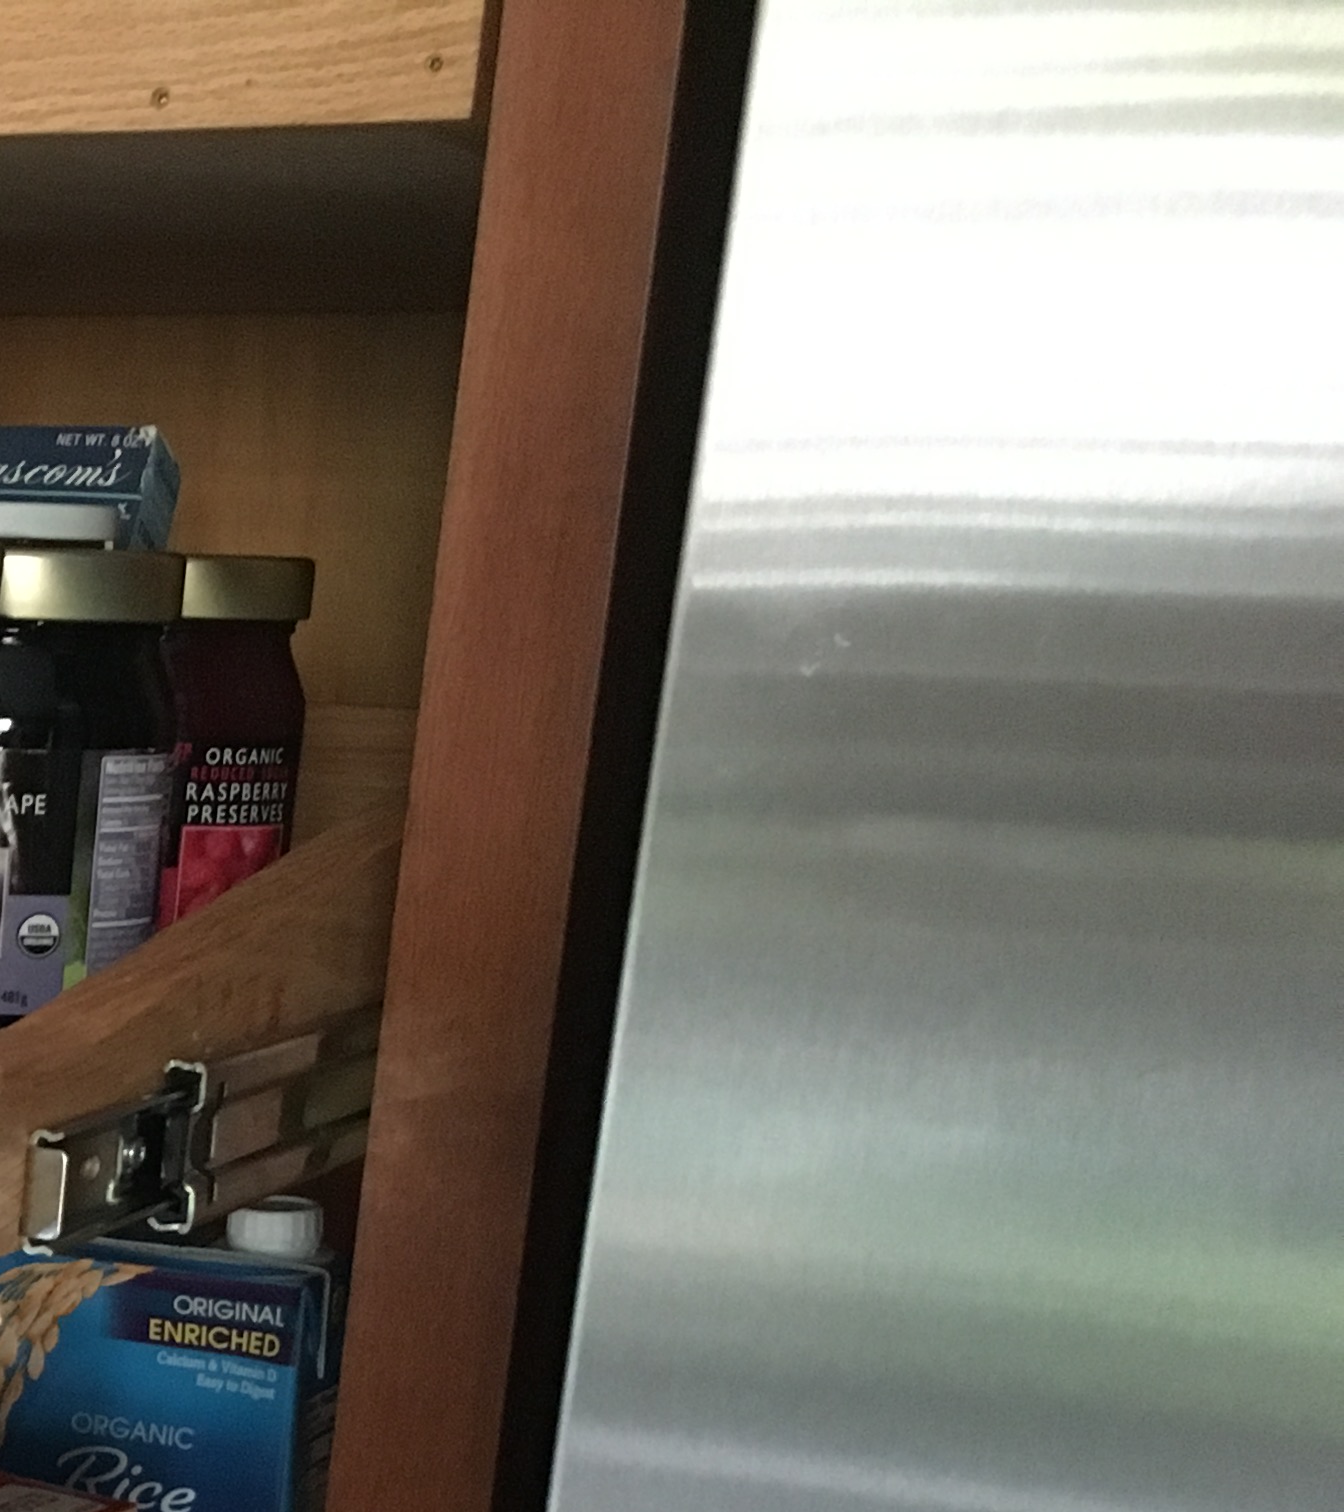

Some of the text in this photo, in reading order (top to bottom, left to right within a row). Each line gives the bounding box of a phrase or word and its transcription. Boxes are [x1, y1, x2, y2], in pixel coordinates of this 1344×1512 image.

[56, 432, 80, 447] NET
[84, 432, 108, 447] WT.
[205, 747, 284, 766] ORGANIC
[185, 781, 288, 802] RASPBERRY
[186, 803, 283, 825] PRESERVES
[173, 1294, 284, 1328] ORIGINAL
[148, 1317, 281, 1358] ENRICHED
[156, 1350, 206, 1371] Calcium
[221, 1360, 265, 1380] Vitamin
[266, 1368, 277, 1383] D
[196, 1373, 276, 1401] Easy to Digest
[71, 1411, 195, 1451] ORGANIC
